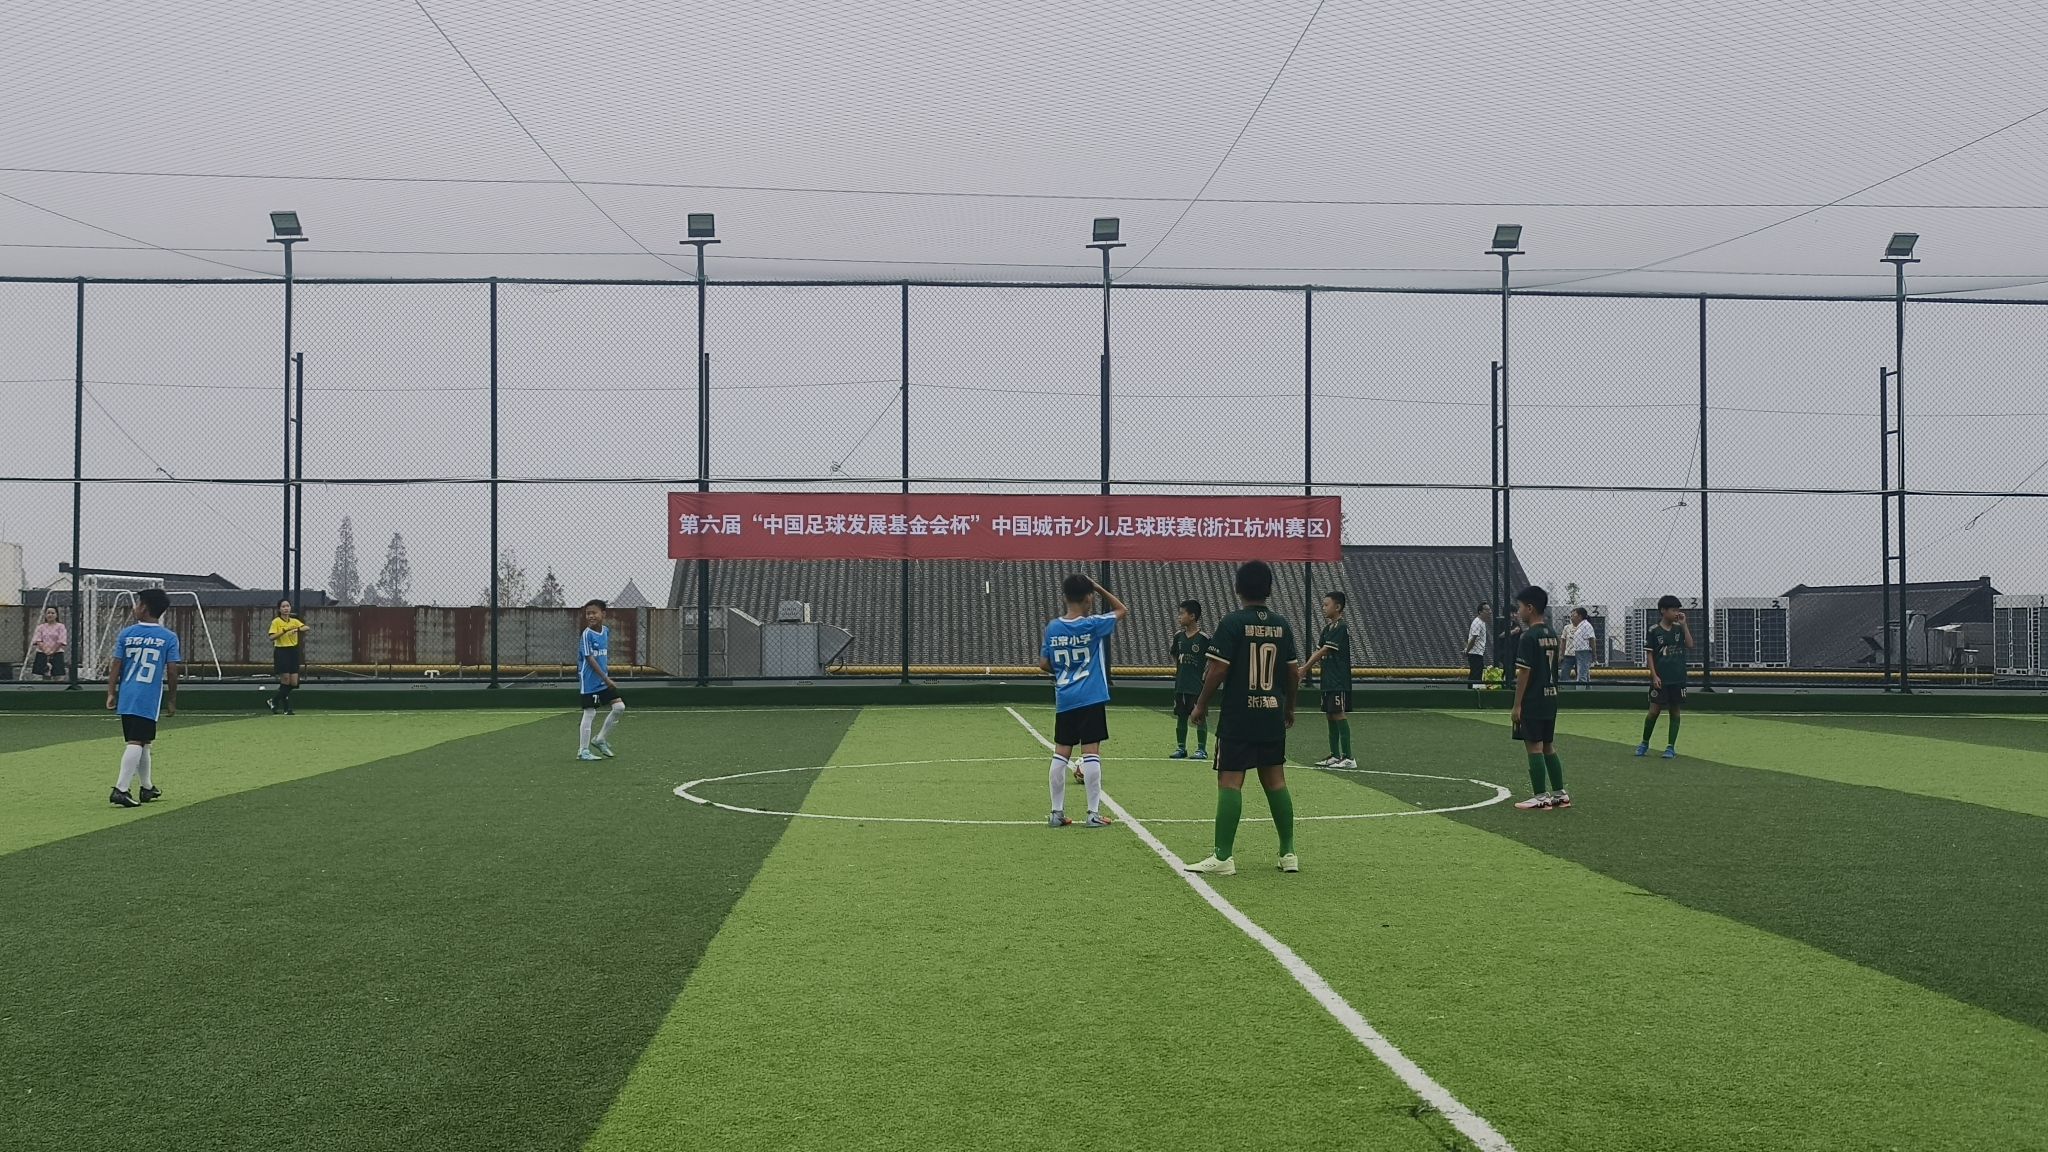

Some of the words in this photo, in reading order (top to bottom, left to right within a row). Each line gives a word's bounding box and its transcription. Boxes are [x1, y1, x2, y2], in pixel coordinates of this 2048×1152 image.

[1772, 600, 1782, 609] 3
[1049, 634, 1091, 646] 五常小学
[1054, 647, 1090, 685] 22
[1248, 642, 1278, 691] 10
